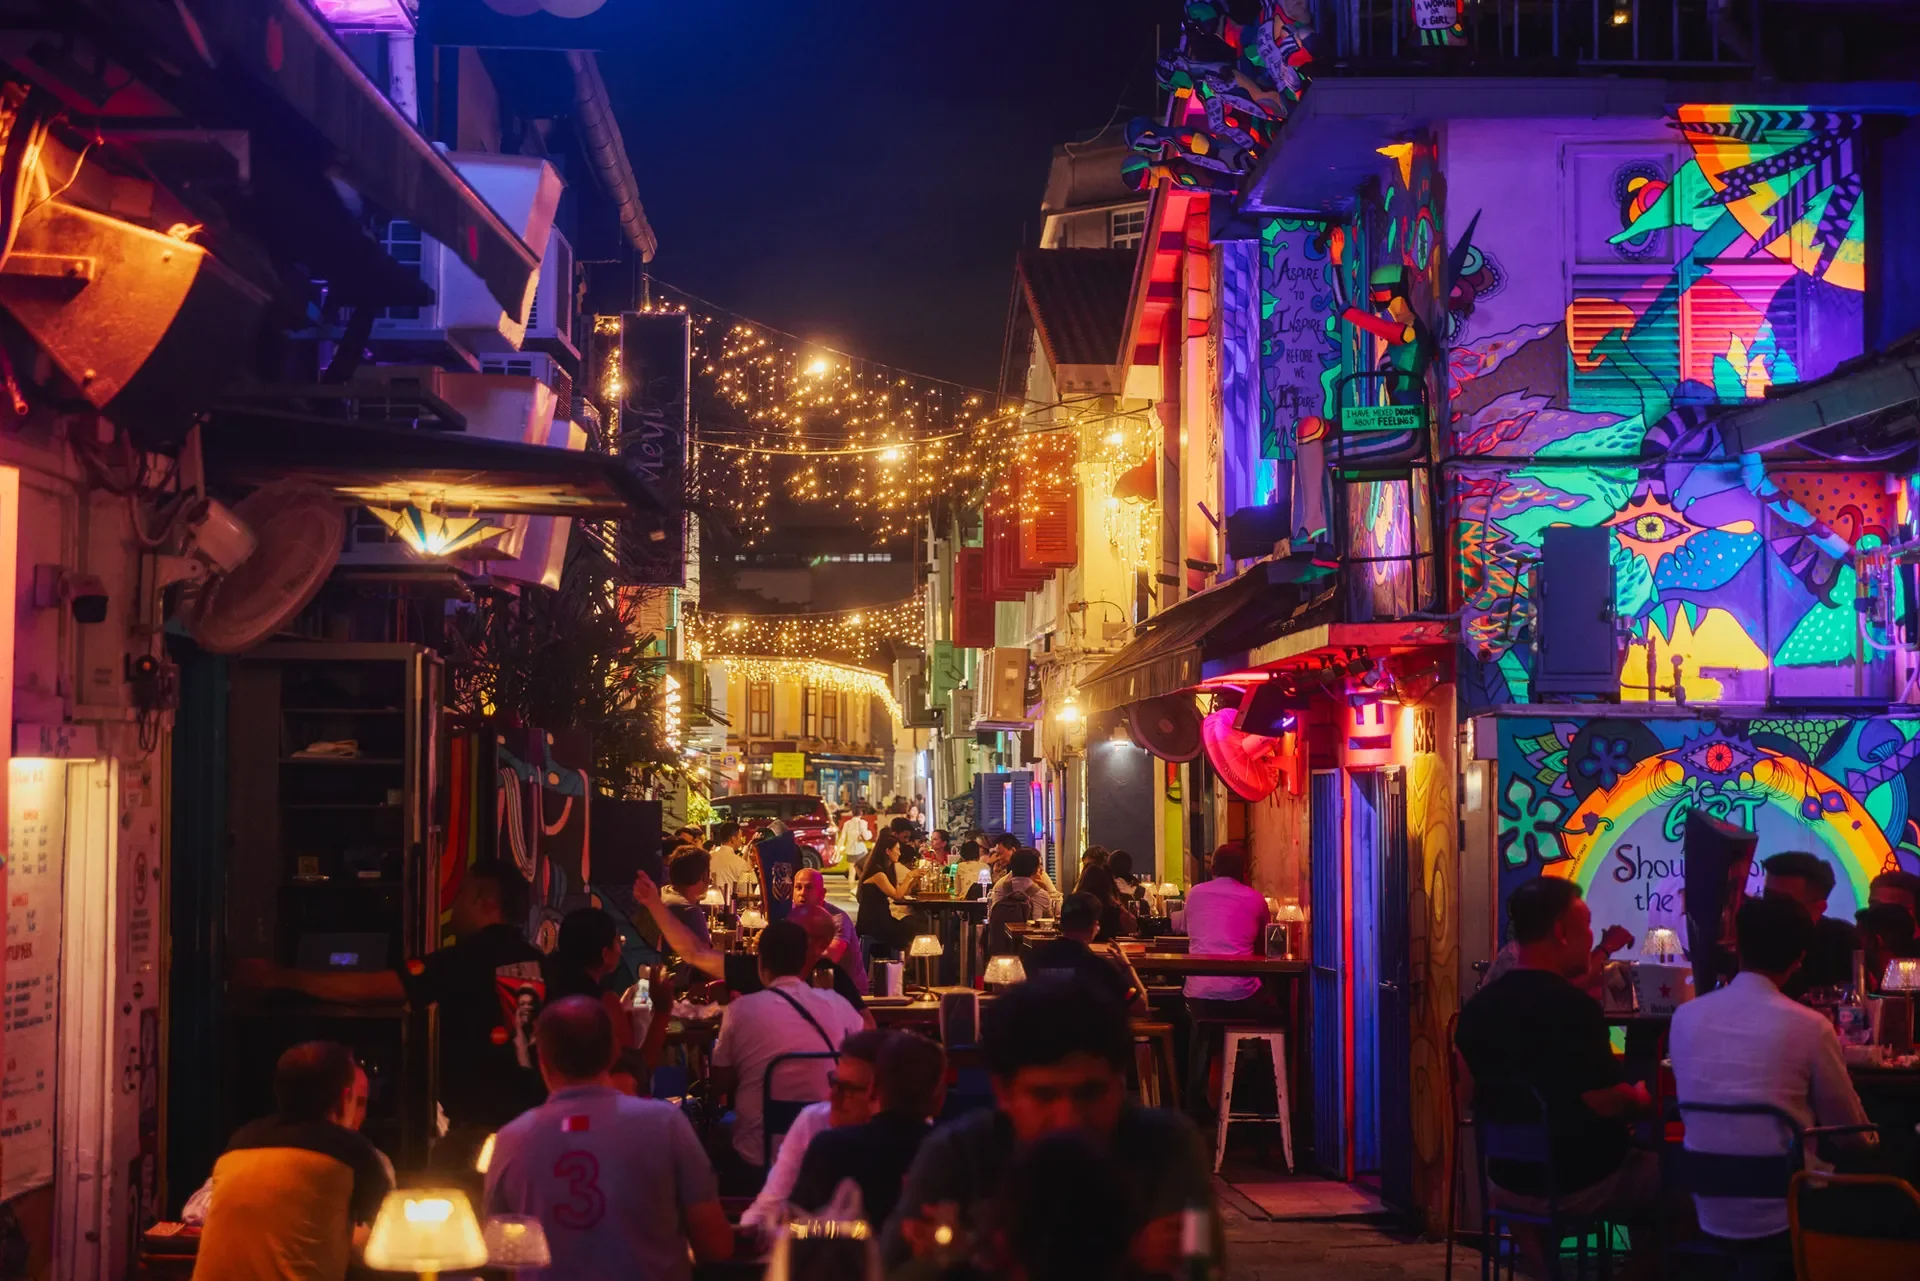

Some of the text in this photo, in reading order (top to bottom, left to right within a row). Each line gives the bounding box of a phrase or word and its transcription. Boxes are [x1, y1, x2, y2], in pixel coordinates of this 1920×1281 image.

[1416, 0, 1456, 11] A WOMAN
[1421, 15, 1451, 26] A GIRL
[1273, 257, 1321, 292] ASPIRE
[1294, 290, 1305, 301] TO
[1273, 305, 1325, 344] INSPIRE
[1286, 348, 1313, 363] BEFORE
[1293, 366, 1305, 379] WE
[1352, 409, 1369, 417] HAVE
[1373, 408, 1394, 417] MIXED
[1395, 407, 1421, 417] DRINKS
[1354, 416, 1414, 426] ABOUT FEELINGS
[1663, 787, 1768, 842] ART
[1612, 844, 1685, 883] Shou
[1635, 882, 1674, 912] the
[553, 1149, 606, 1231] 3
